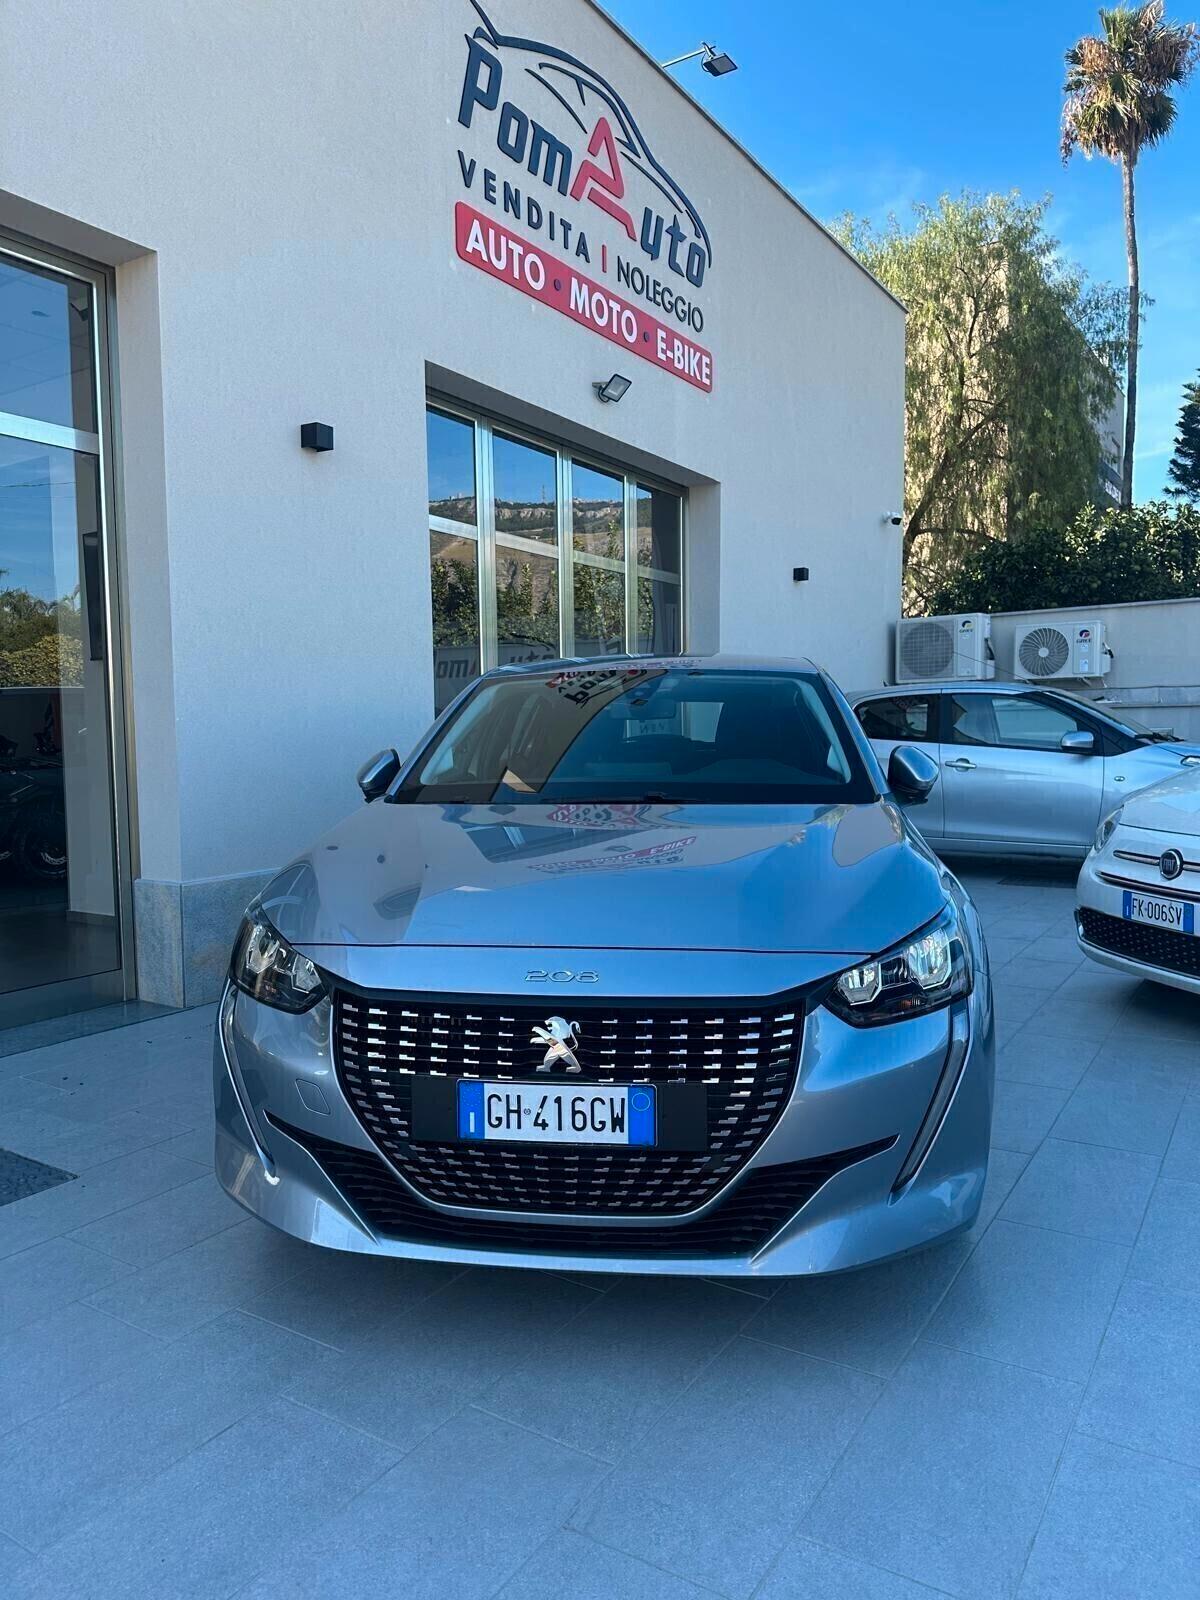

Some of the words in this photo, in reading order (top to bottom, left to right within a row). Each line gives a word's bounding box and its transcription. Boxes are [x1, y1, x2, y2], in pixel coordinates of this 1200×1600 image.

[457, 149, 590, 264] VENDITA
[616, 255, 705, 333] NOLEGGIO
[465, 218, 546, 291] AUTO
[569, 277, 638, 344] MOTO
[656, 328, 711, 386] E-BIKE
[525, 969, 600, 984] 208
